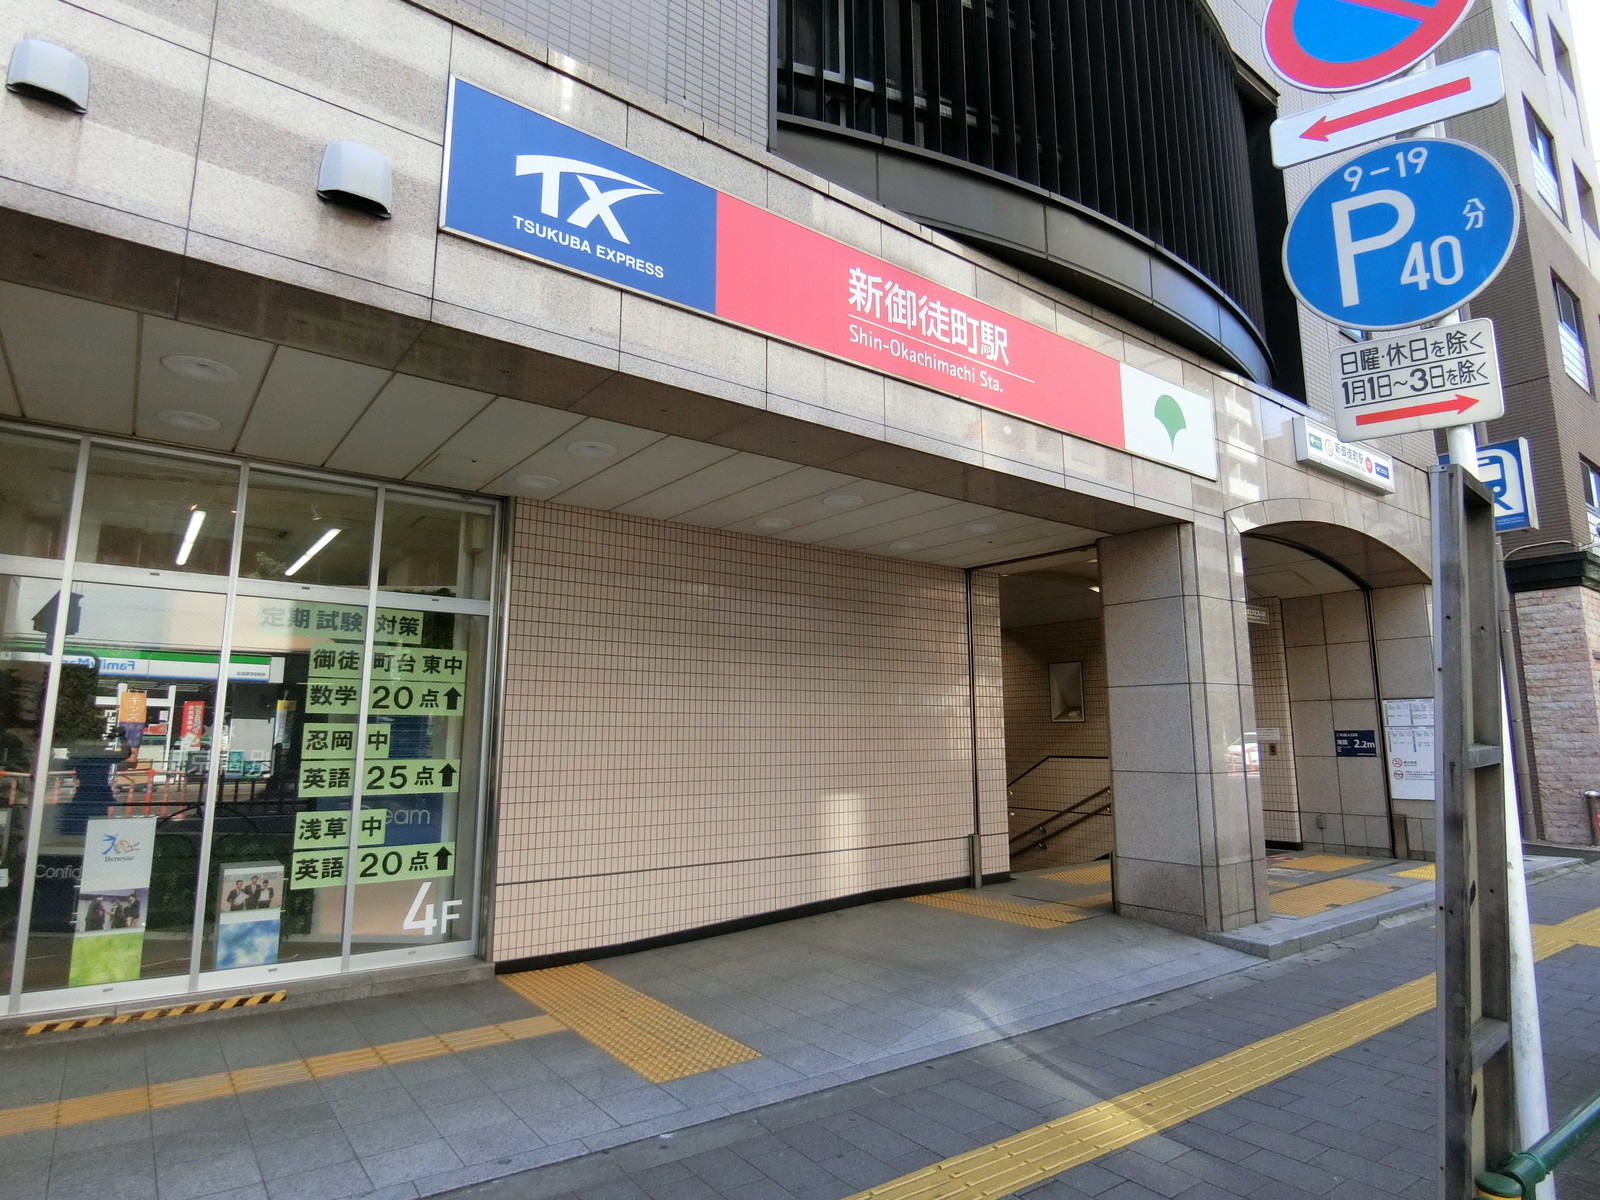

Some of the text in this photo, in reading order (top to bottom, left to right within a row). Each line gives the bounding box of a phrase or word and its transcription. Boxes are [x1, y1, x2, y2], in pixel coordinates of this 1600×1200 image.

[515, 154, 665, 245] TX
[1343, 146, 1428, 192] 9-19
[512, 214, 665, 279] TSUKUBA EXPRESS
[1331, 189, 1416, 308] P
[1400, 197, 1486, 291] 40 分
[847, 267, 1010, 367] 新御徒町駅
[848, 323, 1004, 393] Shin-Okachimachi Sta.
[402, 881, 463, 936] 4F
